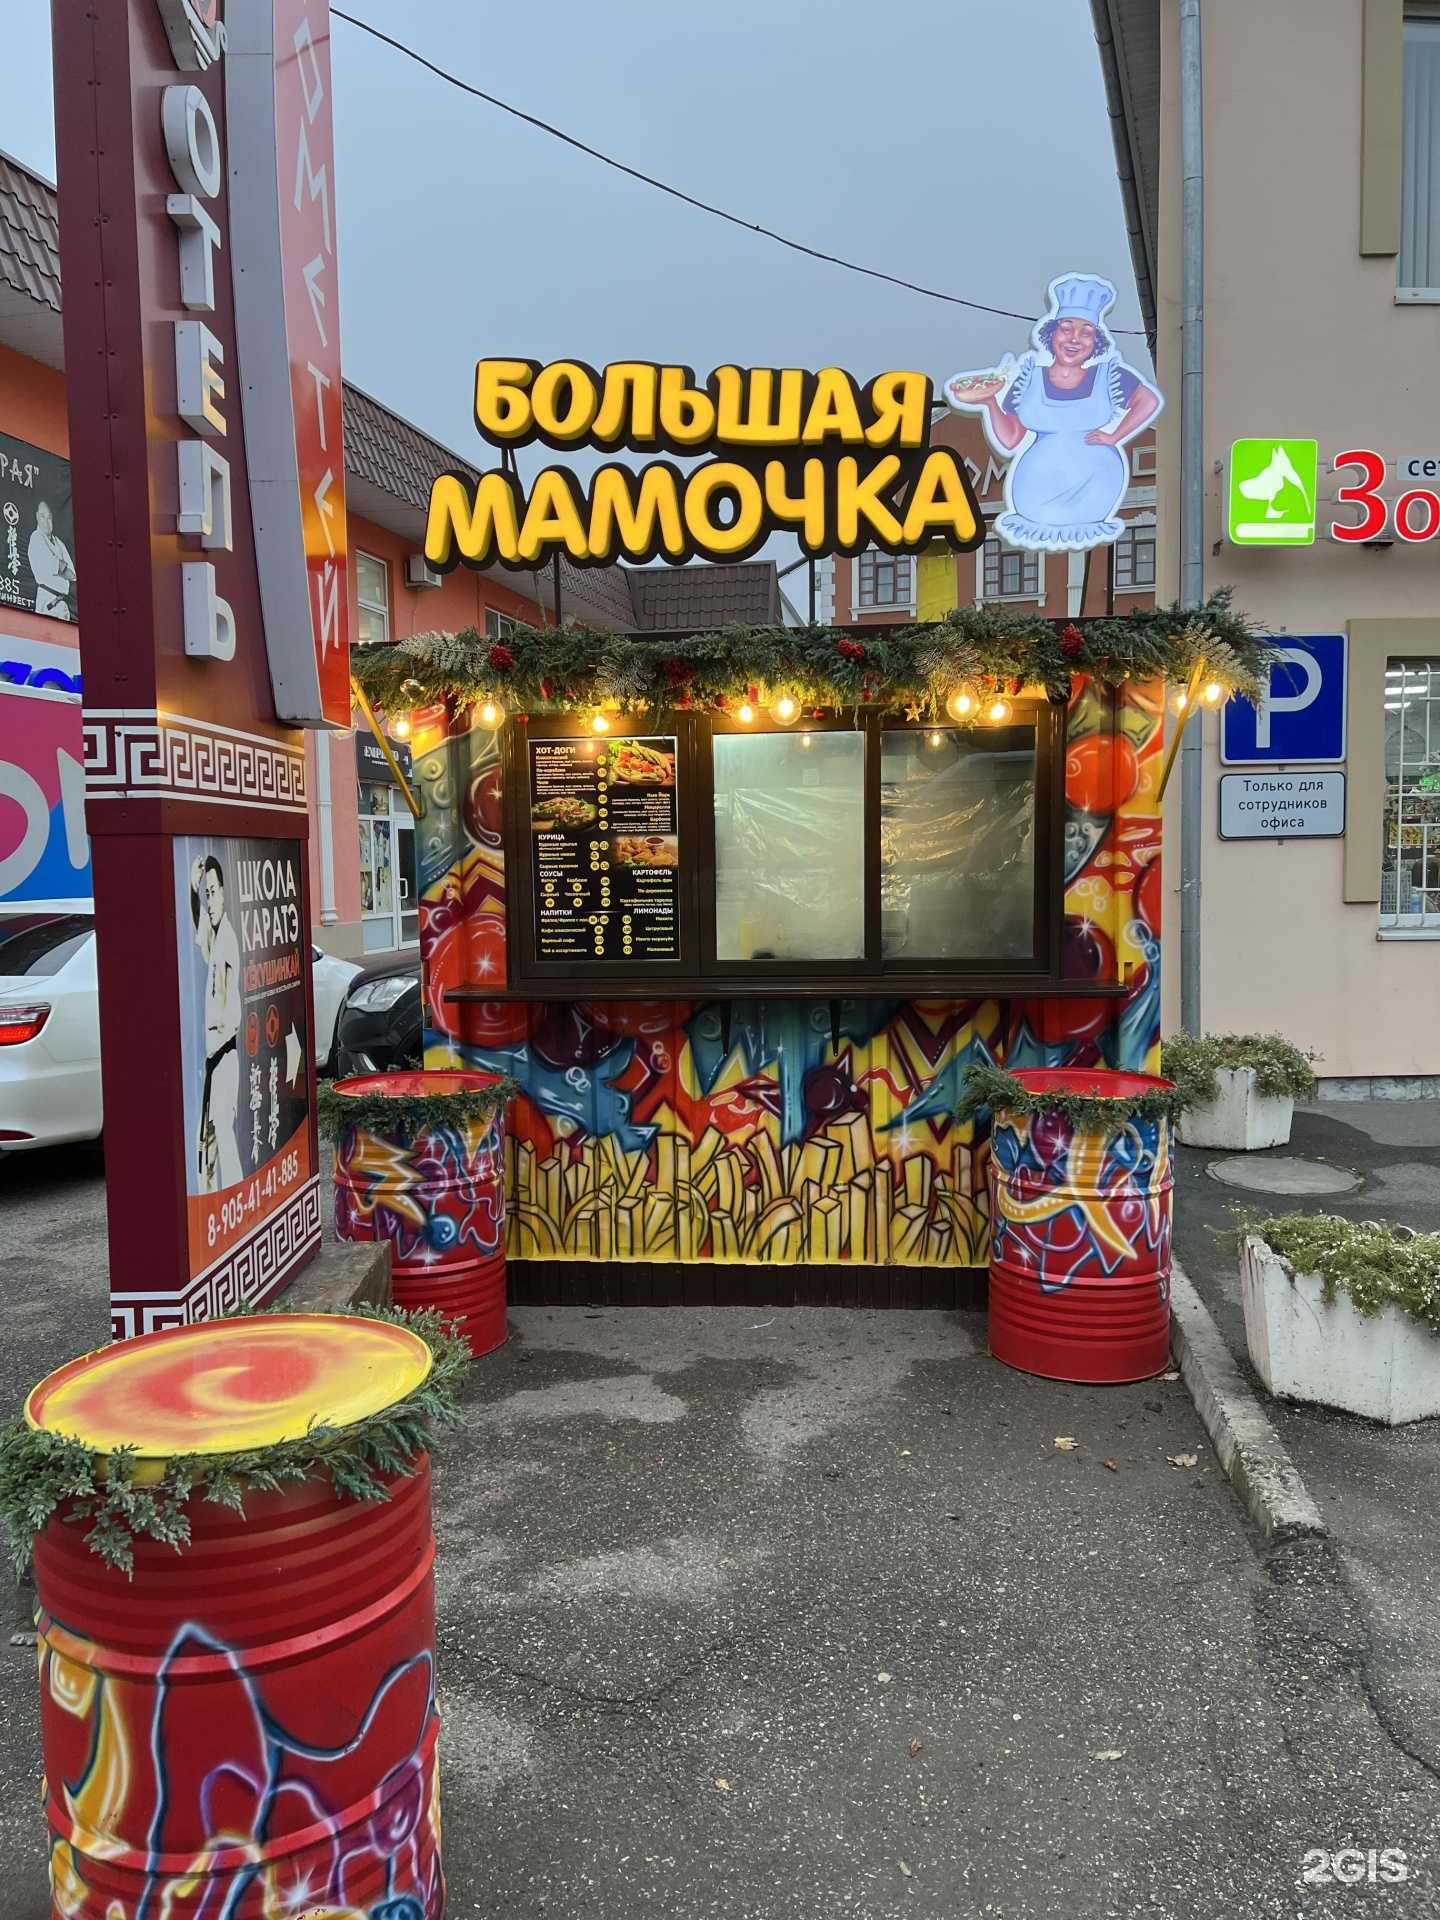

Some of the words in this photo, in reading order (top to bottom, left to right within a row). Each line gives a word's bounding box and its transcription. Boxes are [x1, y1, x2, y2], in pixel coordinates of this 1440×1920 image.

[474, 360, 929, 448] БОЛЬШАЯ
[1407, 460, 1440, 477] се
[424, 450, 977, 566] МАМОЧКА
[1255, 647, 1323, 749] P
[535, 746, 576, 755] ХОТ-ДОГИ
[1243, 780, 1293, 792] Только
[1299, 781, 1324, 792] для
[1238, 799, 1328, 812] сотрудников
[1261, 816, 1305, 831] офиса
[237, 859, 297, 902] ШКОЛА
[633, 907, 674, 915] ЛИМОНАДЫ
[240, 903, 299, 952] КАРАТЭ
[206, 1150, 299, 1247] 8-905-41-41-885
